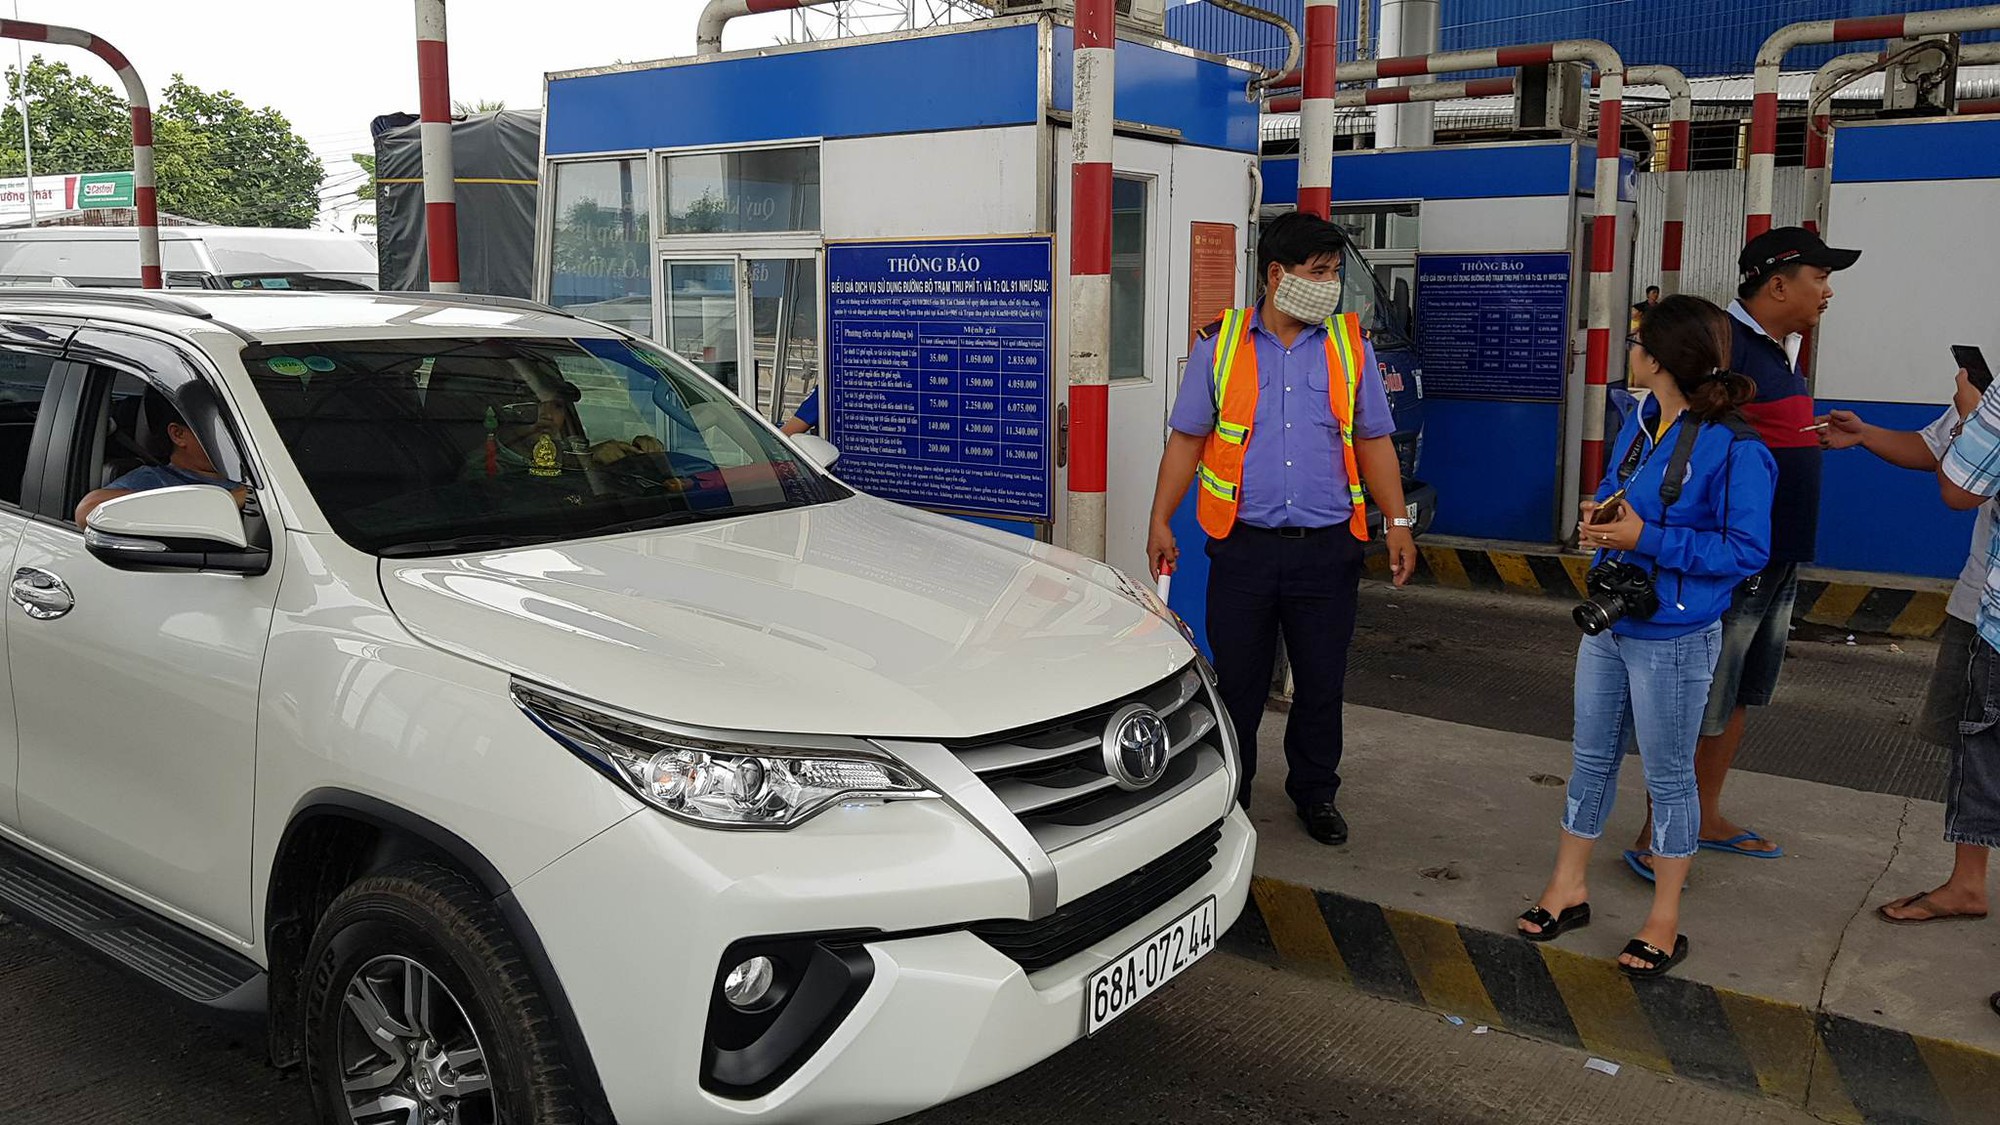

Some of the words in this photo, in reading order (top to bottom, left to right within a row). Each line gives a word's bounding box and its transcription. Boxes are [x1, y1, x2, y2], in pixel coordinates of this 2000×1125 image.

[32, 189, 53, 200] hát
[91, 184, 114, 195] Castrol
[887, 253, 942, 273] THÔNG
[946, 252, 980, 272] BÁO
[1460, 260, 1498, 271] THÔNG
[1501, 259, 1524, 270] BÁO
[831, 275, 844, 293] BIỂU
[845, 278, 854, 293] GIÁ
[855, 281, 868, 295] DỊCH
[869, 281, 876, 295] VỤ
[877, 277, 886, 293] SỬ
[886, 281, 902, 295] DỤNG
[903, 277, 923, 293] ĐƯỜNG
[924, 278, 933, 295] BỘ
[934, 281, 950, 295] TRẠM
[952, 281, 963, 292] THU
[965, 277, 975, 292] PHÍ
[976, 281, 982, 292] T1
[983, 277, 992, 292] VÀ
[993, 280, 1000, 292] T2
[1001, 280, 1010, 292] QL
[1011, 280, 1018, 292] 91
[1019, 278, 1033, 292] NHƯ
[1034, 279, 1049, 292] SAU:
[1094, 907, 1211, 1022] 68A-072.44
